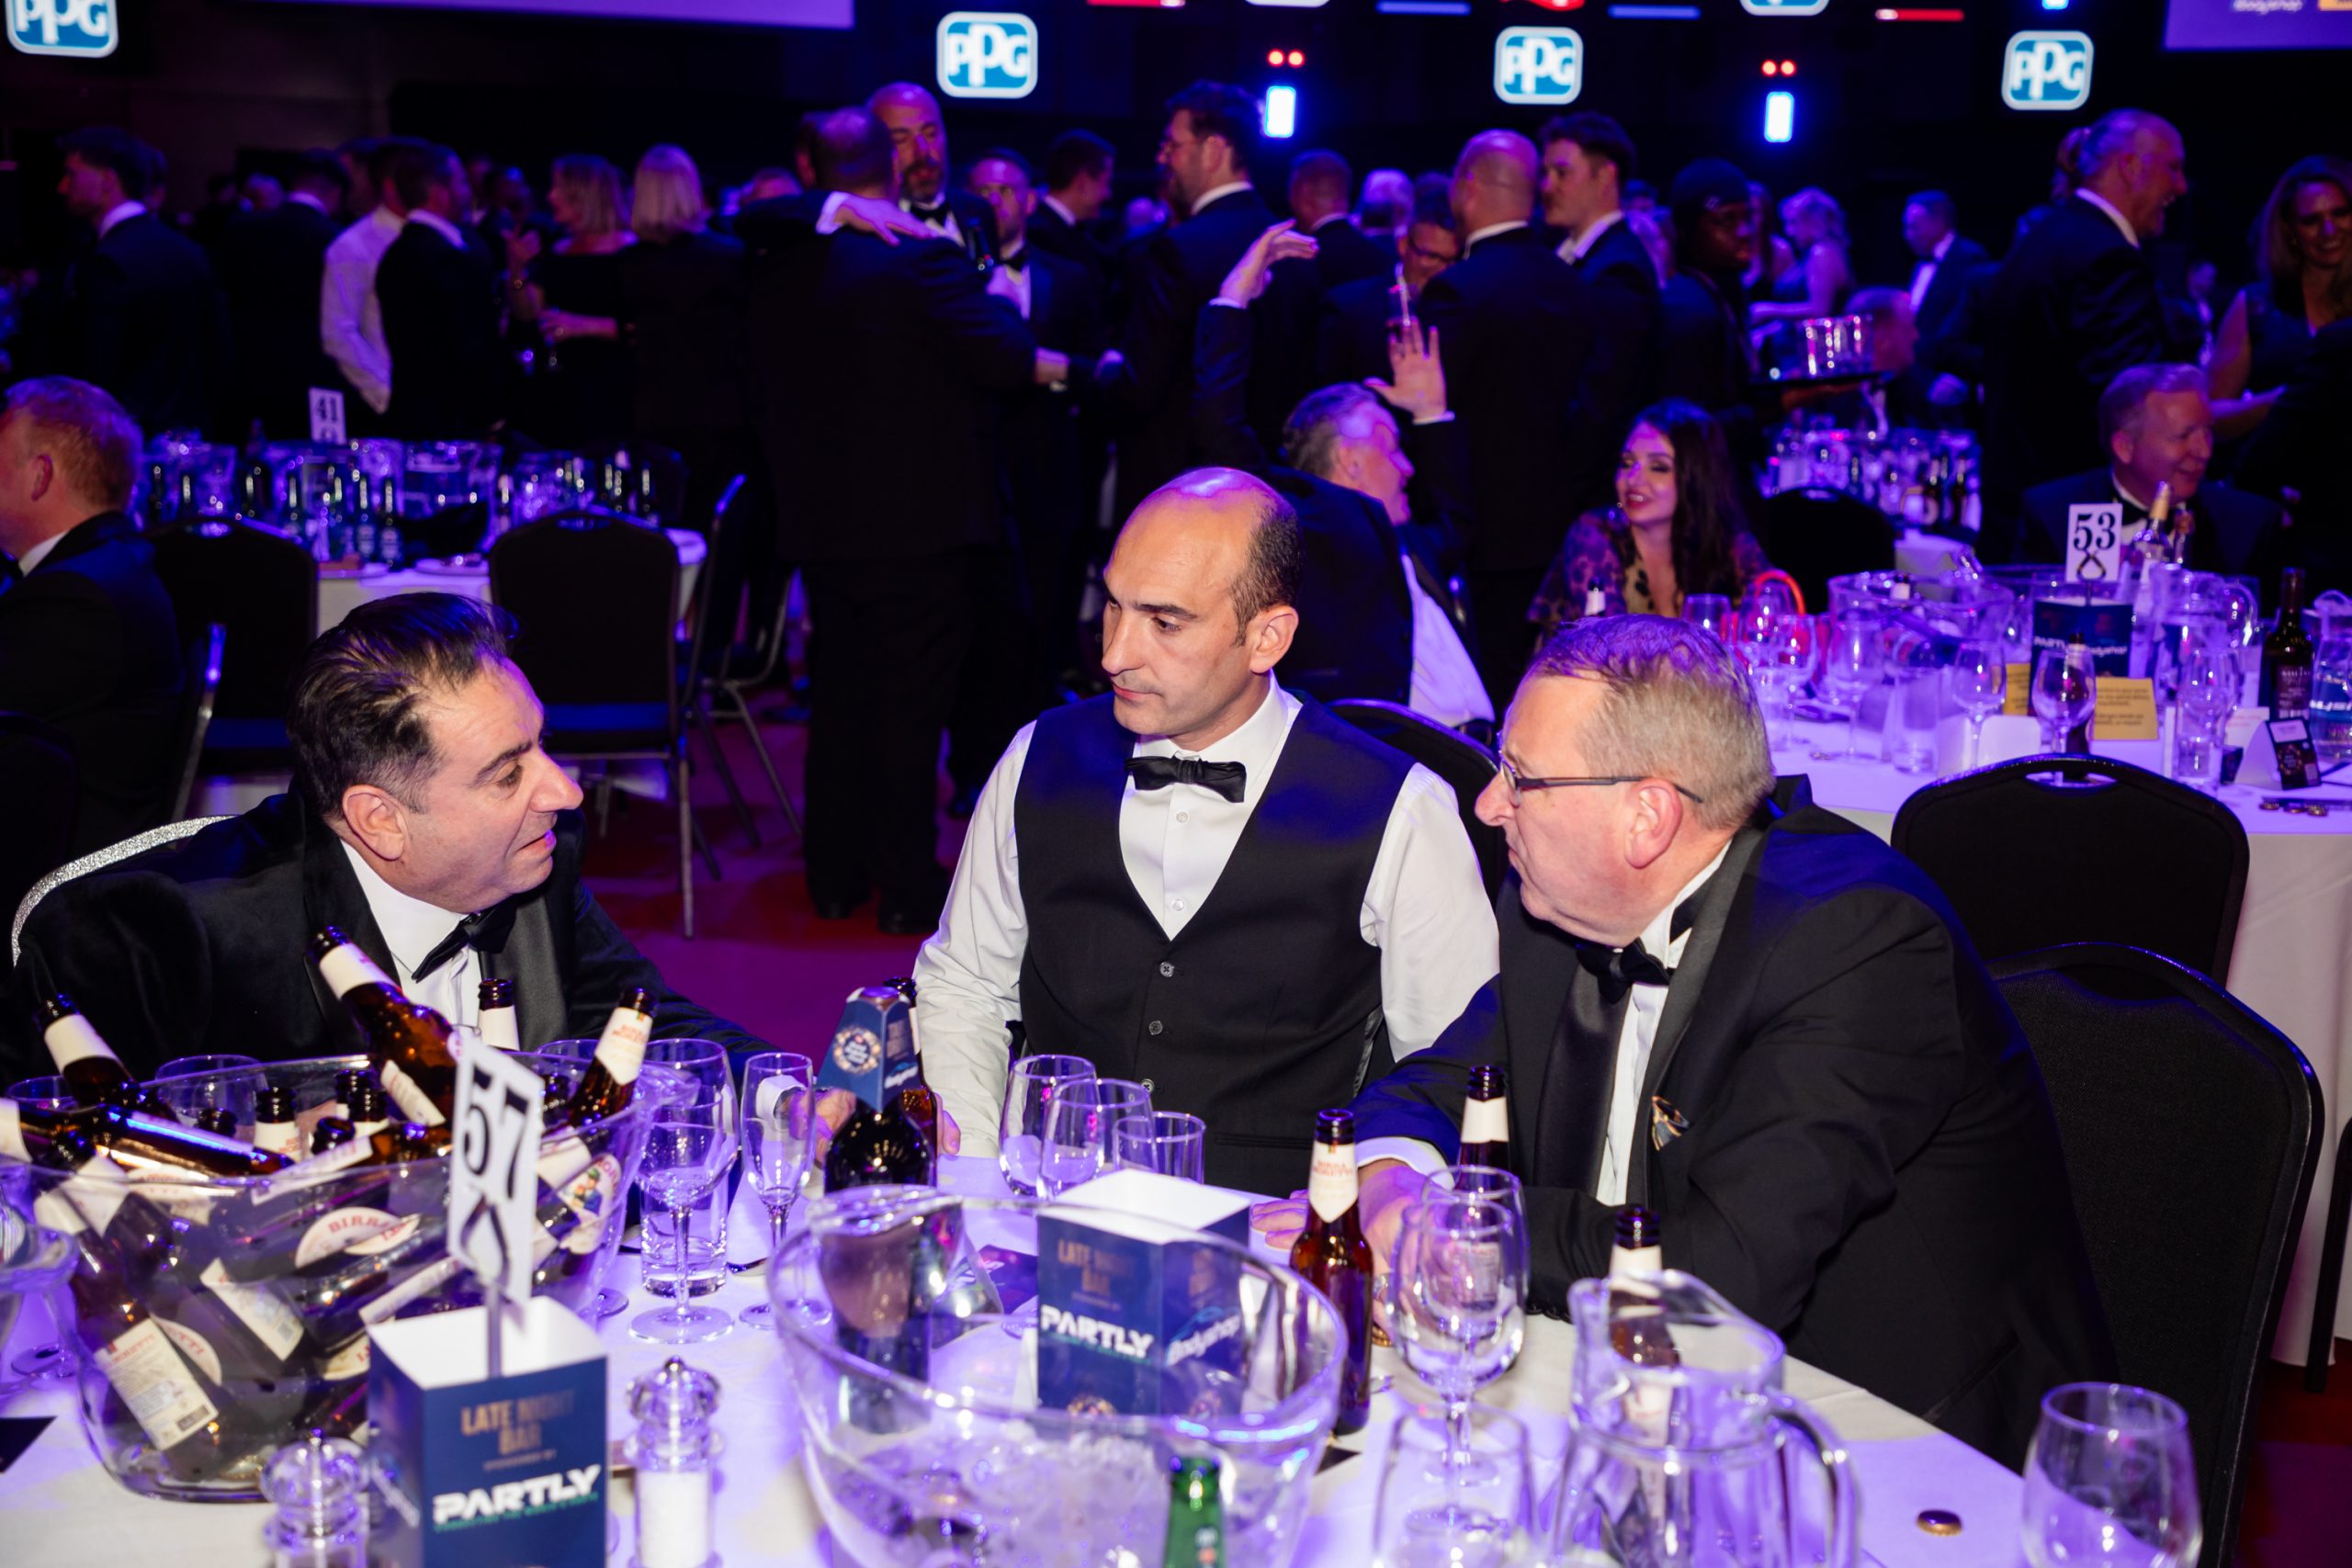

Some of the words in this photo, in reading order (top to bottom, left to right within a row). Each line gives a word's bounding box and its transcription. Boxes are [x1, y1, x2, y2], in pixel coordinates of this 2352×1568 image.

[15, 0, 108, 45] PPG
[946, 23, 1028, 87] PPG
[1503, 37, 1575, 94] PPG
[2011, 40, 2084, 99] PPG
[2073, 512, 2116, 551] 53
[463, 1065, 531, 1201] 57
[1040, 1303, 1154, 1359] PARTLY
[460, 1399, 513, 1437] LATE
[432, 1462, 602, 1525] PARTLY
